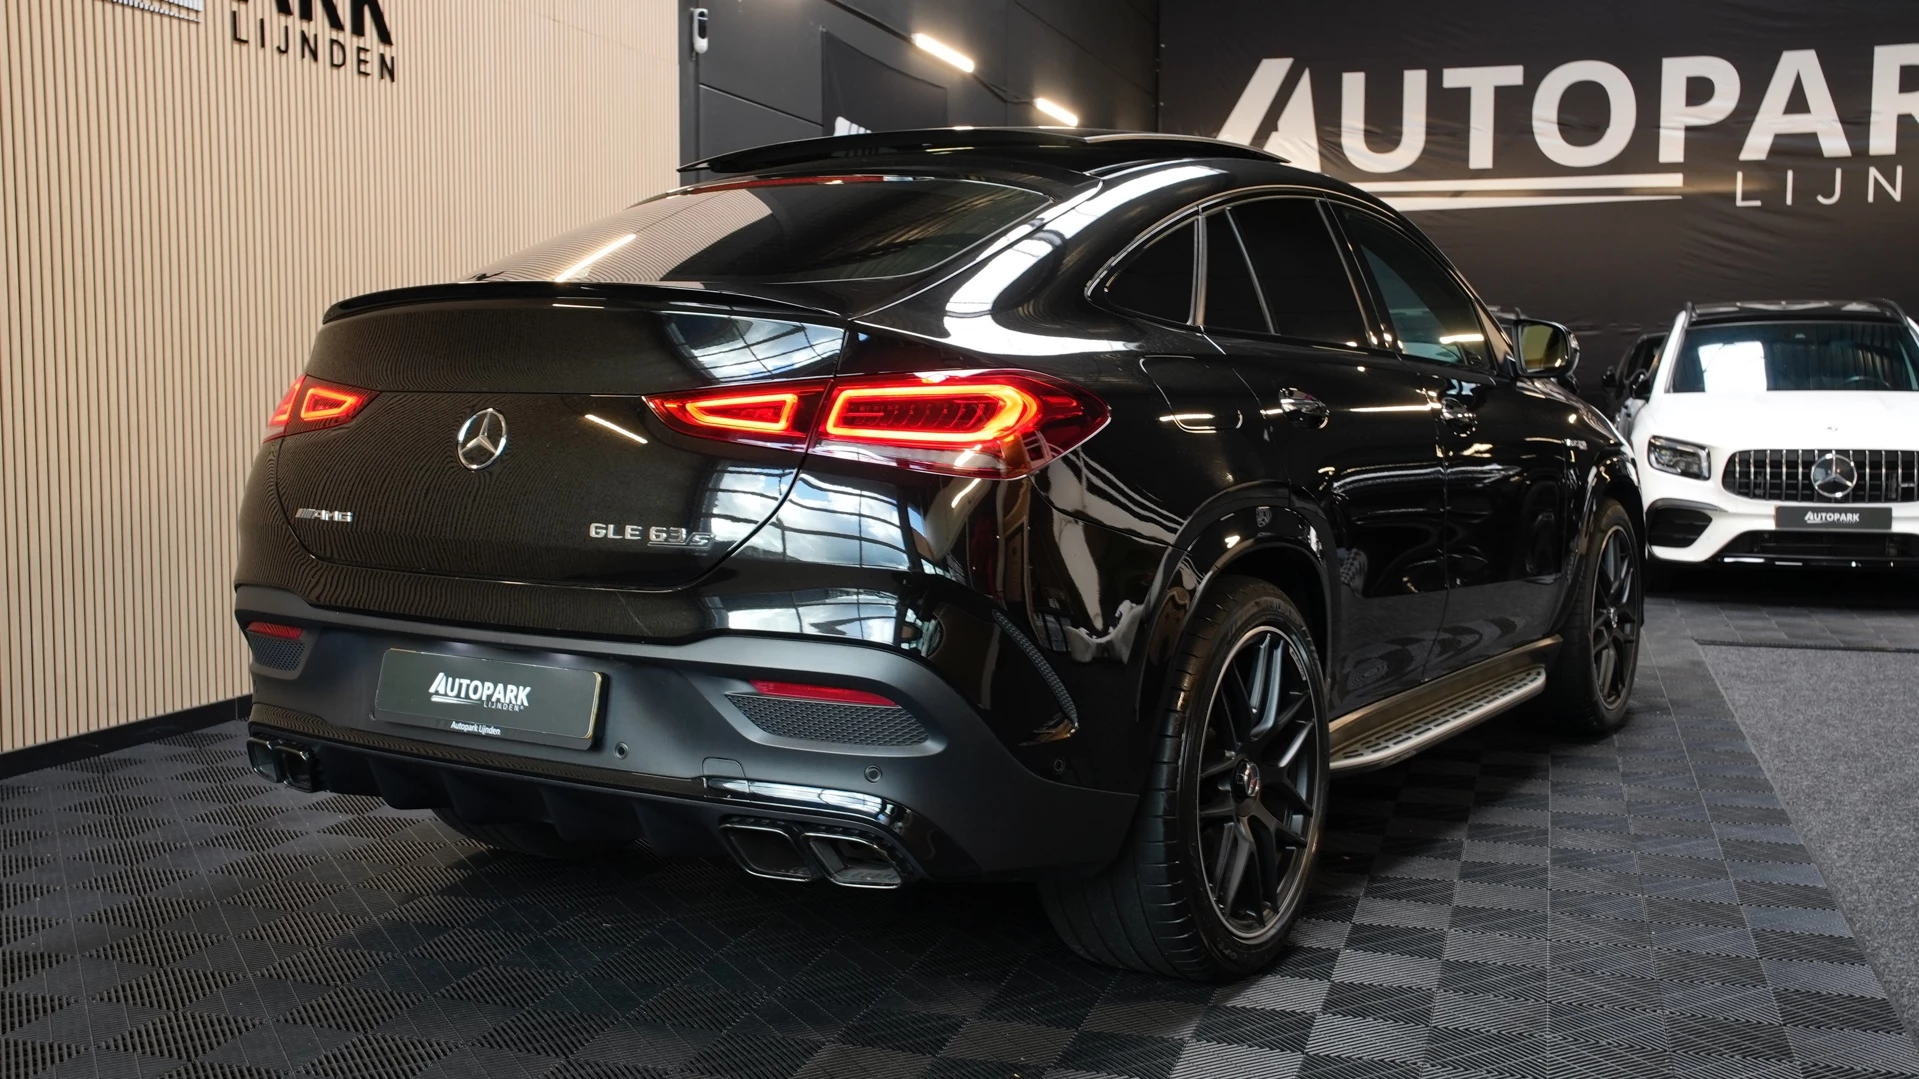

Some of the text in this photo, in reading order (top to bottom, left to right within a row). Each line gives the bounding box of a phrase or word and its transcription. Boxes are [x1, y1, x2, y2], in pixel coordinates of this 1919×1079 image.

[231, 10, 395, 83] LIJNDEN
[1735, 164, 1903, 208] LIJN
[1804, 510, 1860, 522] AUTOPARK
[589, 522, 643, 540] GLE
[428, 672, 532, 707] AUTOPARK
[451, 721, 501, 735] Autopark Lijnden
